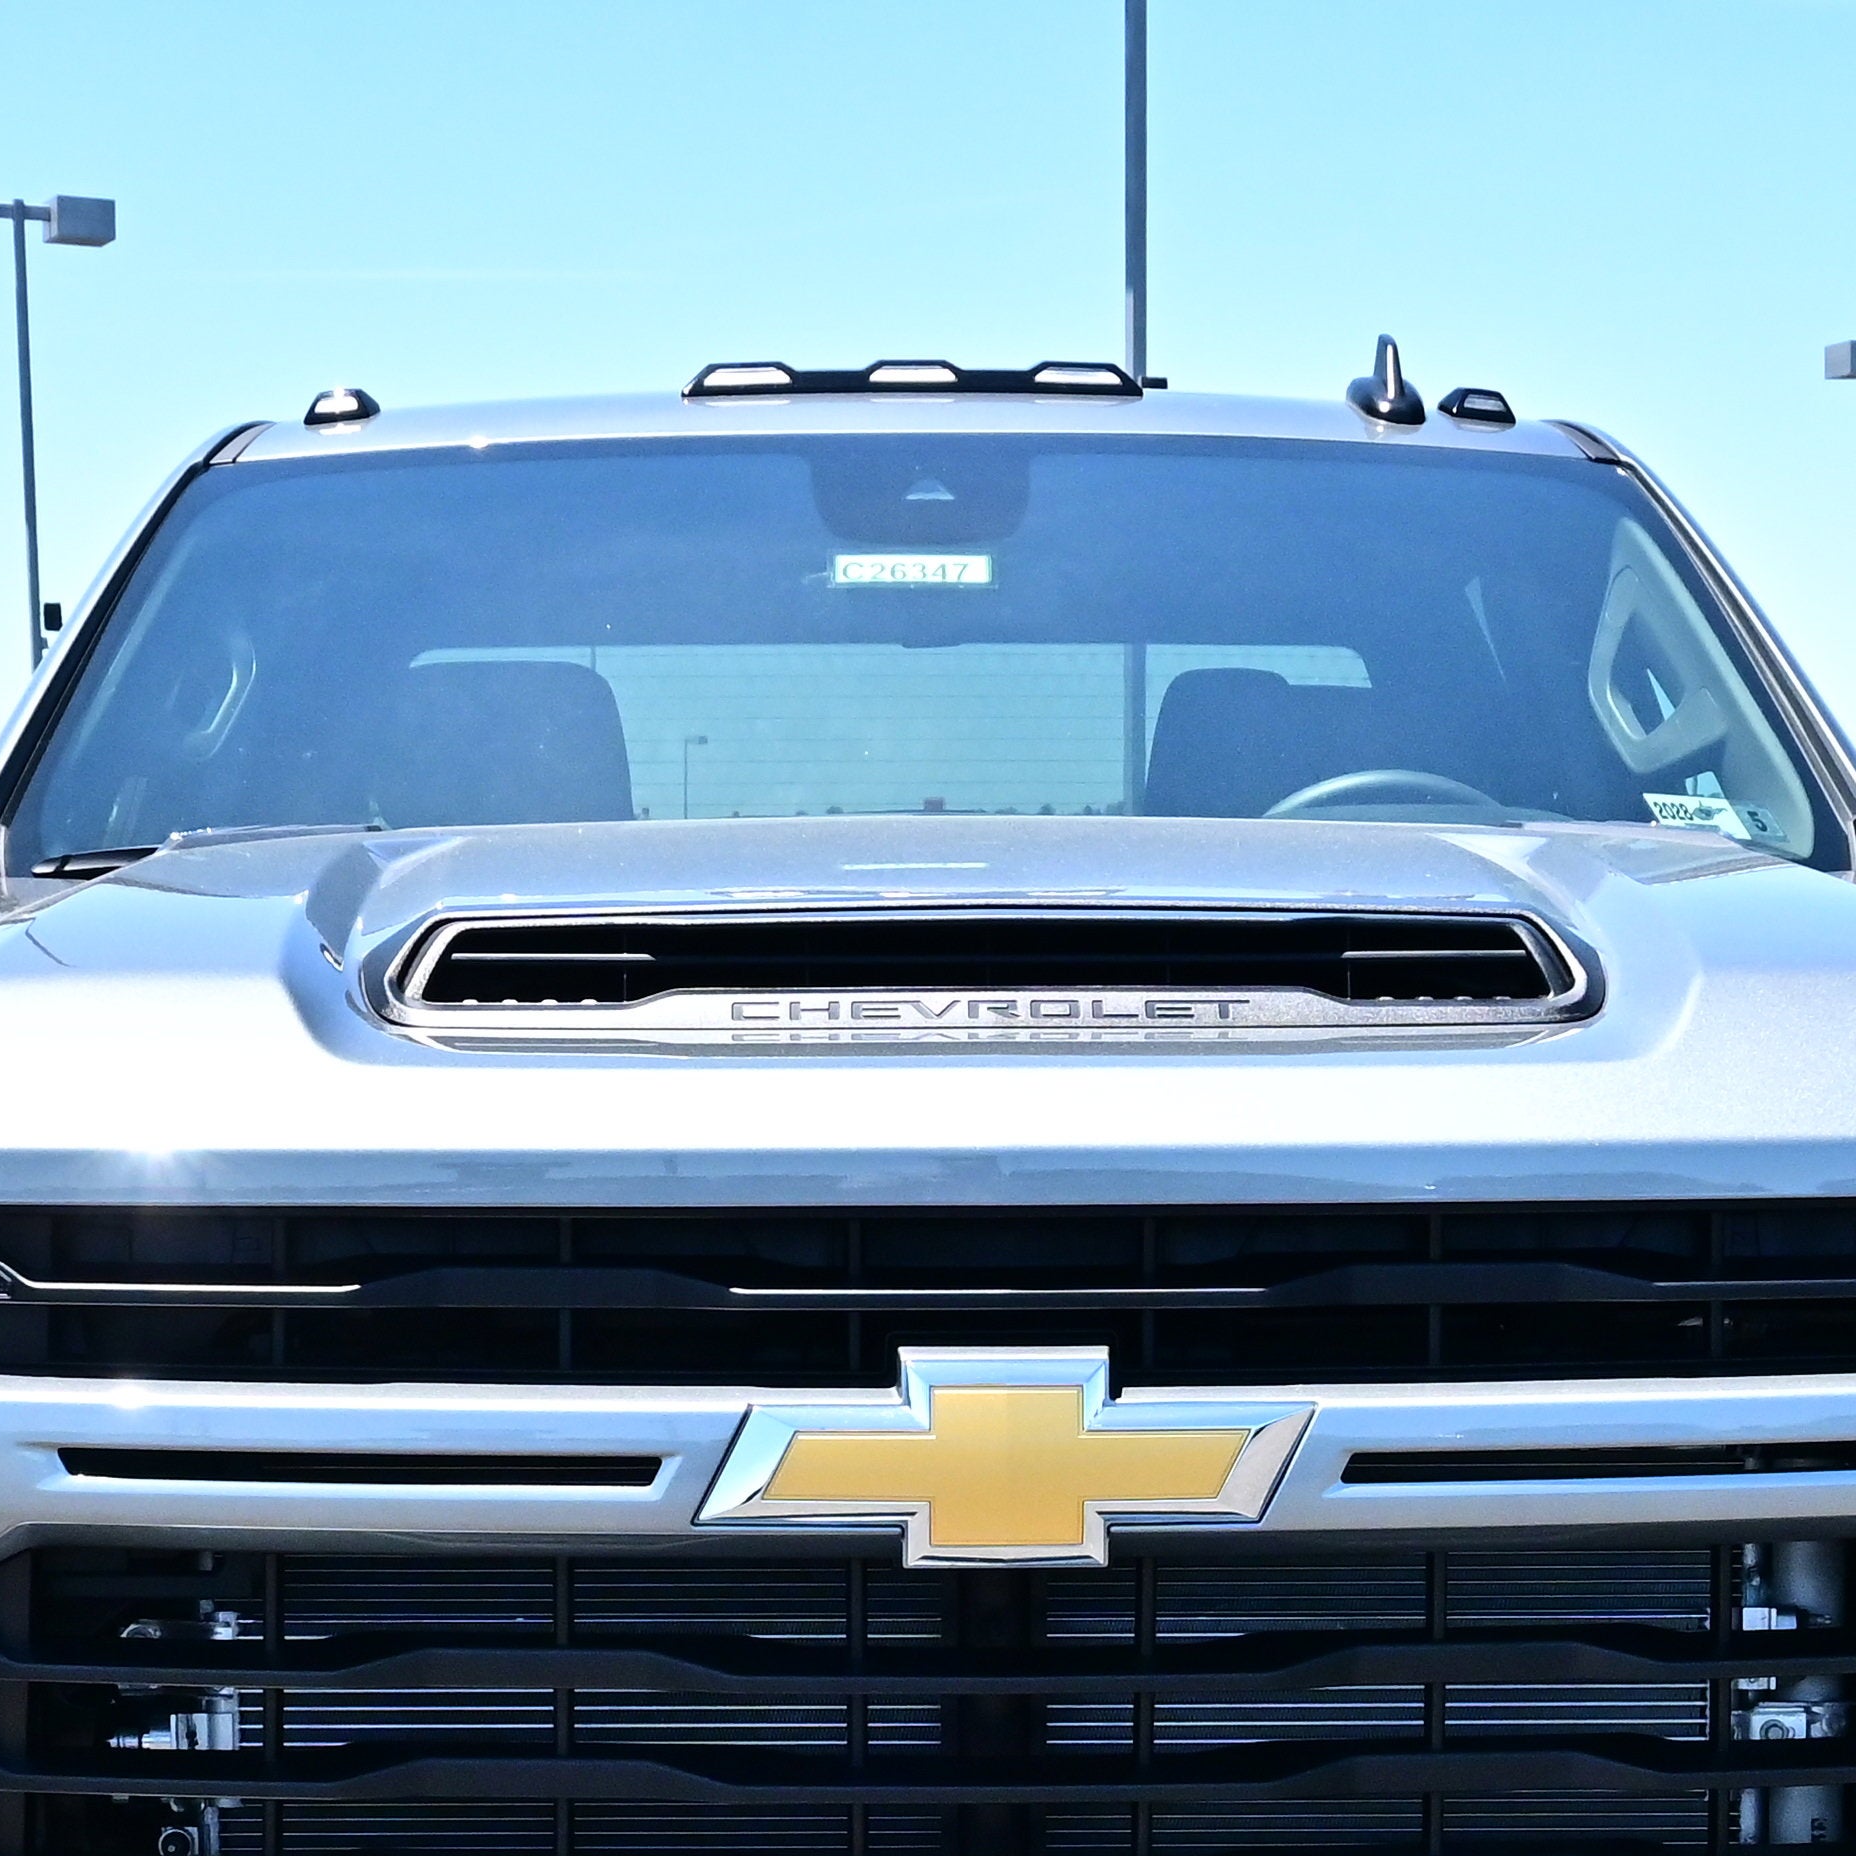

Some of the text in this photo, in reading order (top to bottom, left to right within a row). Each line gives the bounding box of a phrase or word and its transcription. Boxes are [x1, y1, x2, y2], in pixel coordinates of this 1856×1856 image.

[841, 561, 970, 584] C26347
[1653, 801, 1695, 822] 2028
[1747, 810, 1769, 833] 5
[730, 998, 1252, 1022] CHEVROLET
